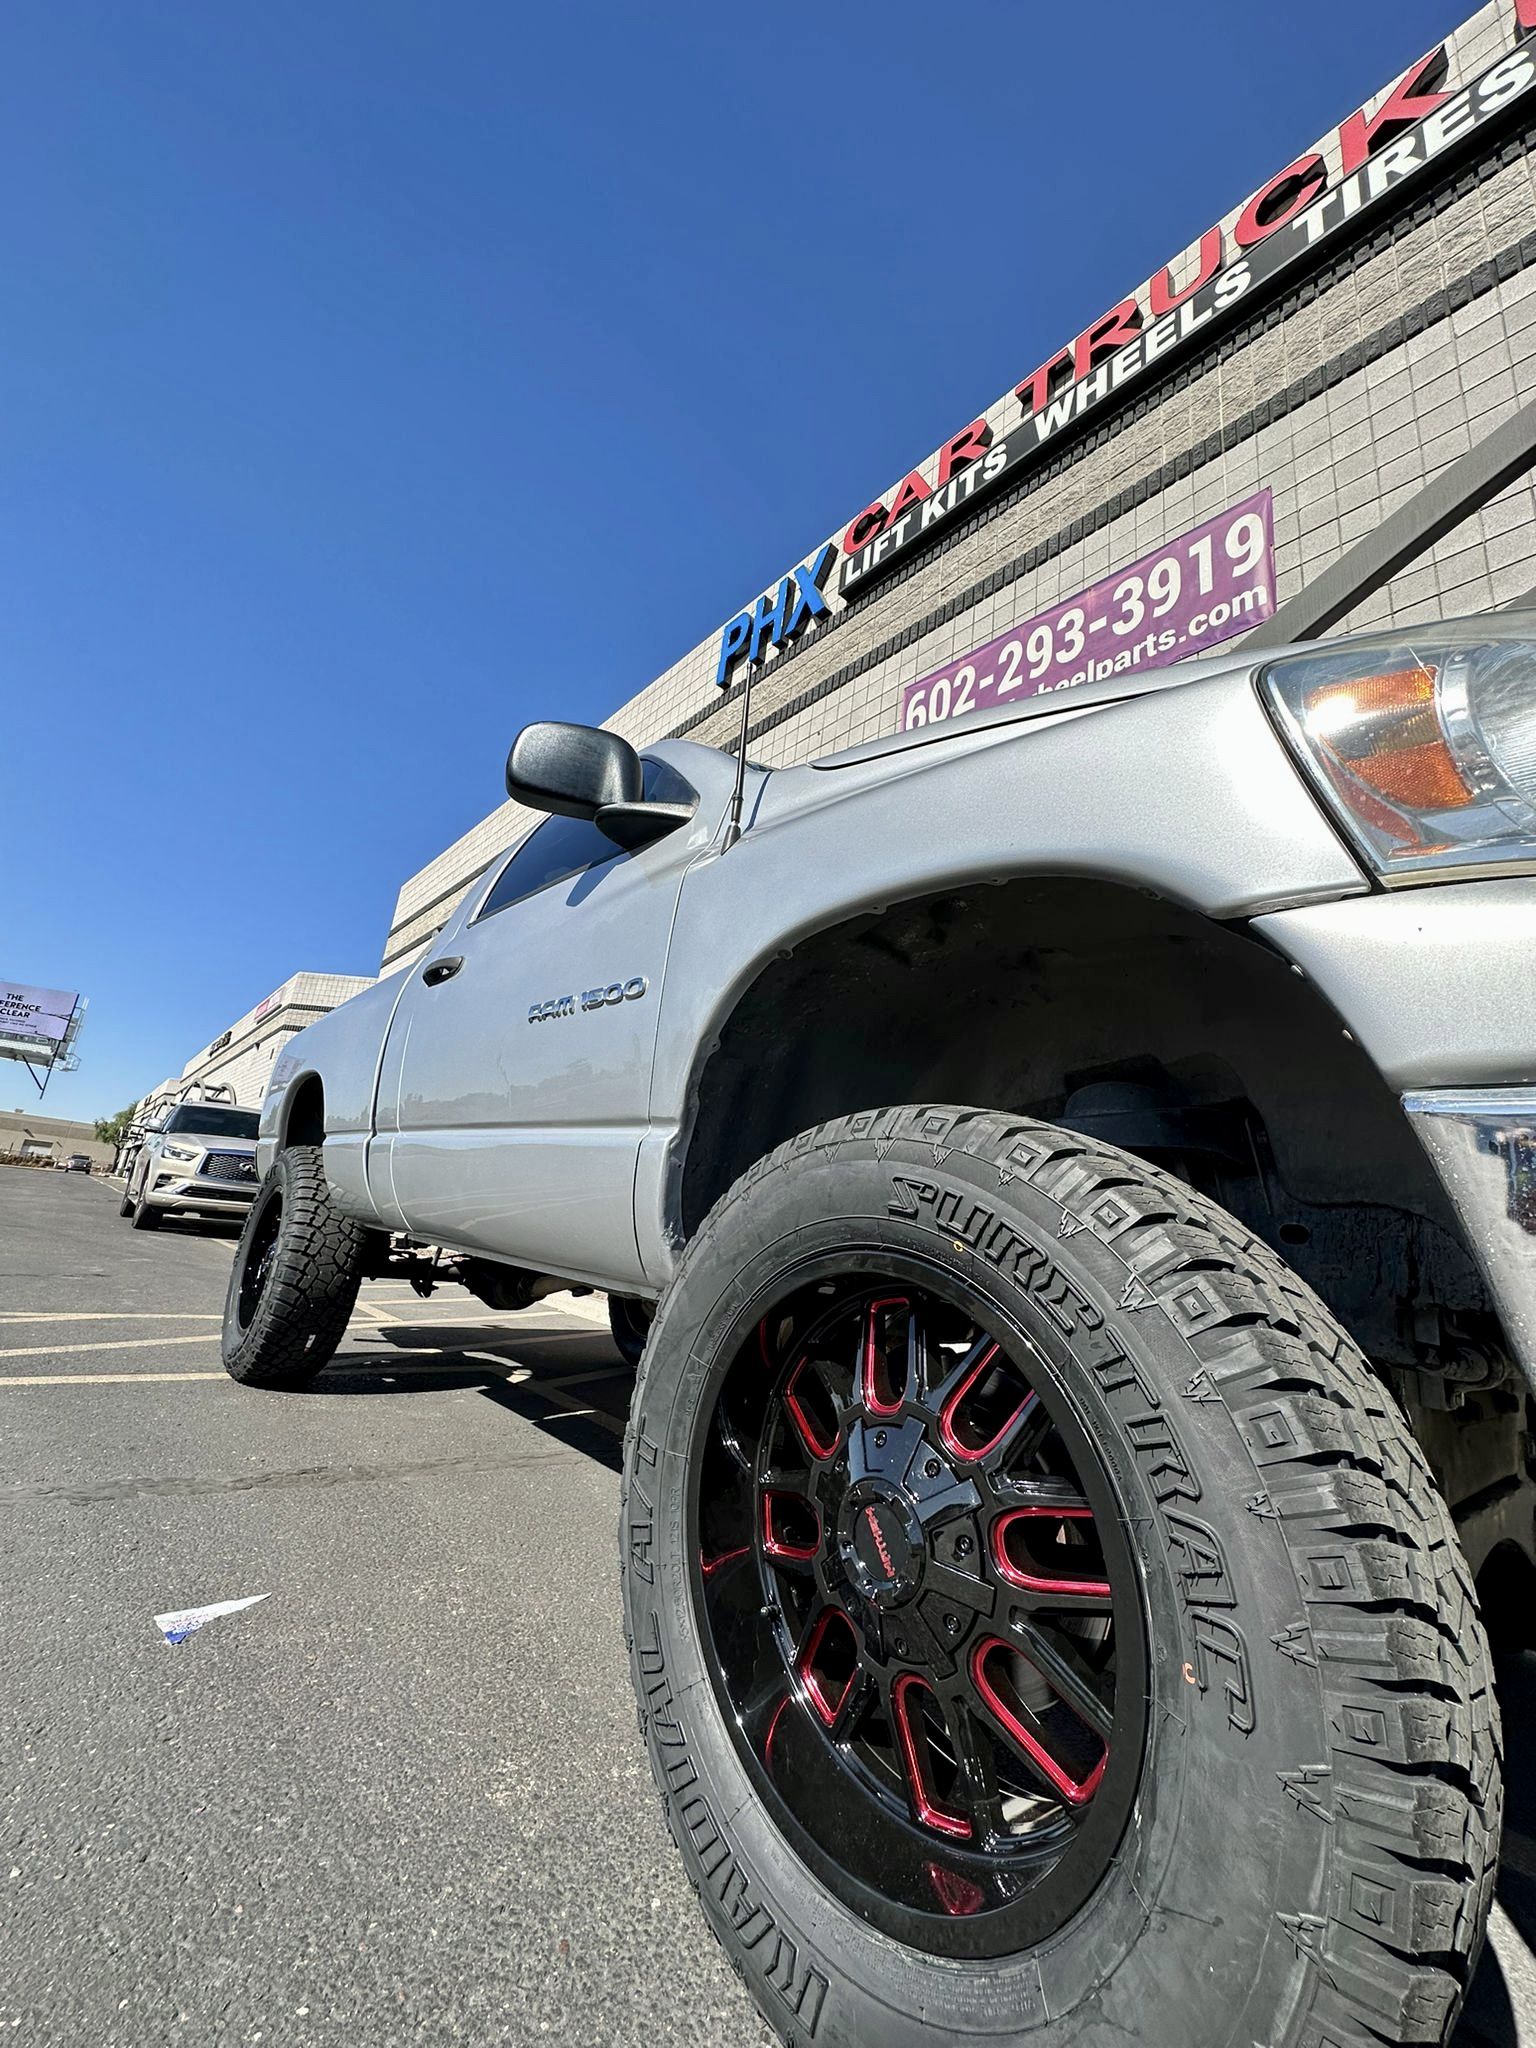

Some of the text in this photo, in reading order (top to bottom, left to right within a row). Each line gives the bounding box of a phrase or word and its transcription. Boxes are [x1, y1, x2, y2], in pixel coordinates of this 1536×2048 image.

[716, 45, 1455, 688] PHX CAR TRUCK
[845, 51, 1535, 587] LIFT KITS WHEELS TIRES
[905, 513, 1265, 731] 602-293-3919
[6, 993, 24, 1001] THE
[528, 976, 648, 1024] RAM 1500
[629, 1413, 830, 2039] RADIAL A/T
